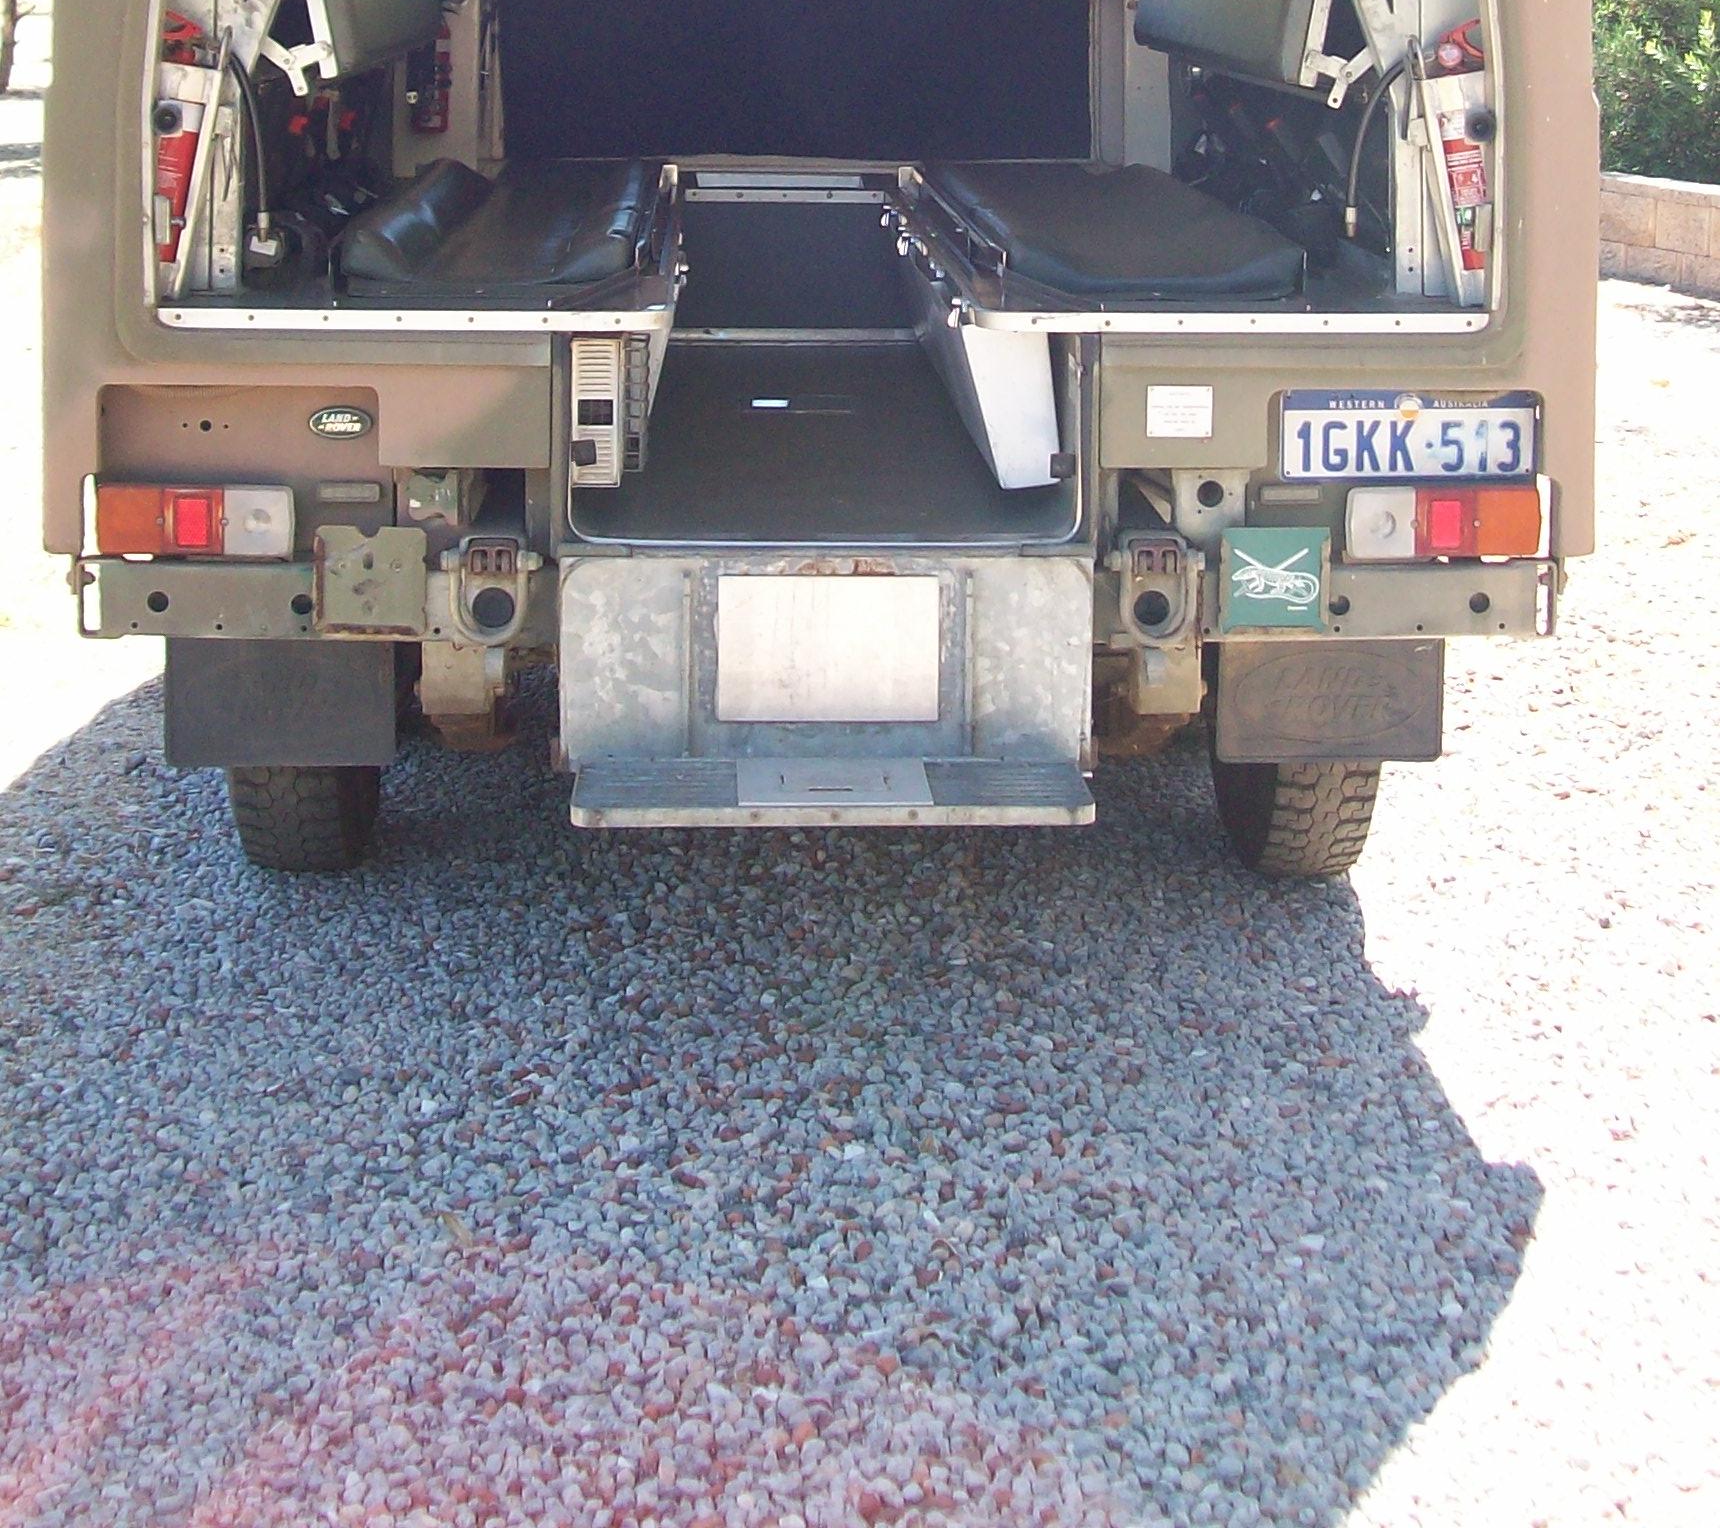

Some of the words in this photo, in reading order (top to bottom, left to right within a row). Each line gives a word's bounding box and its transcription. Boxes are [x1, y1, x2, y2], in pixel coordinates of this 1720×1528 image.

[1328, 399, 1386, 410] WESTERN
[1432, 398, 1489, 409] AUSTRALIA
[321, 413, 352, 423] LAND
[323, 422, 362, 432] ROVER
